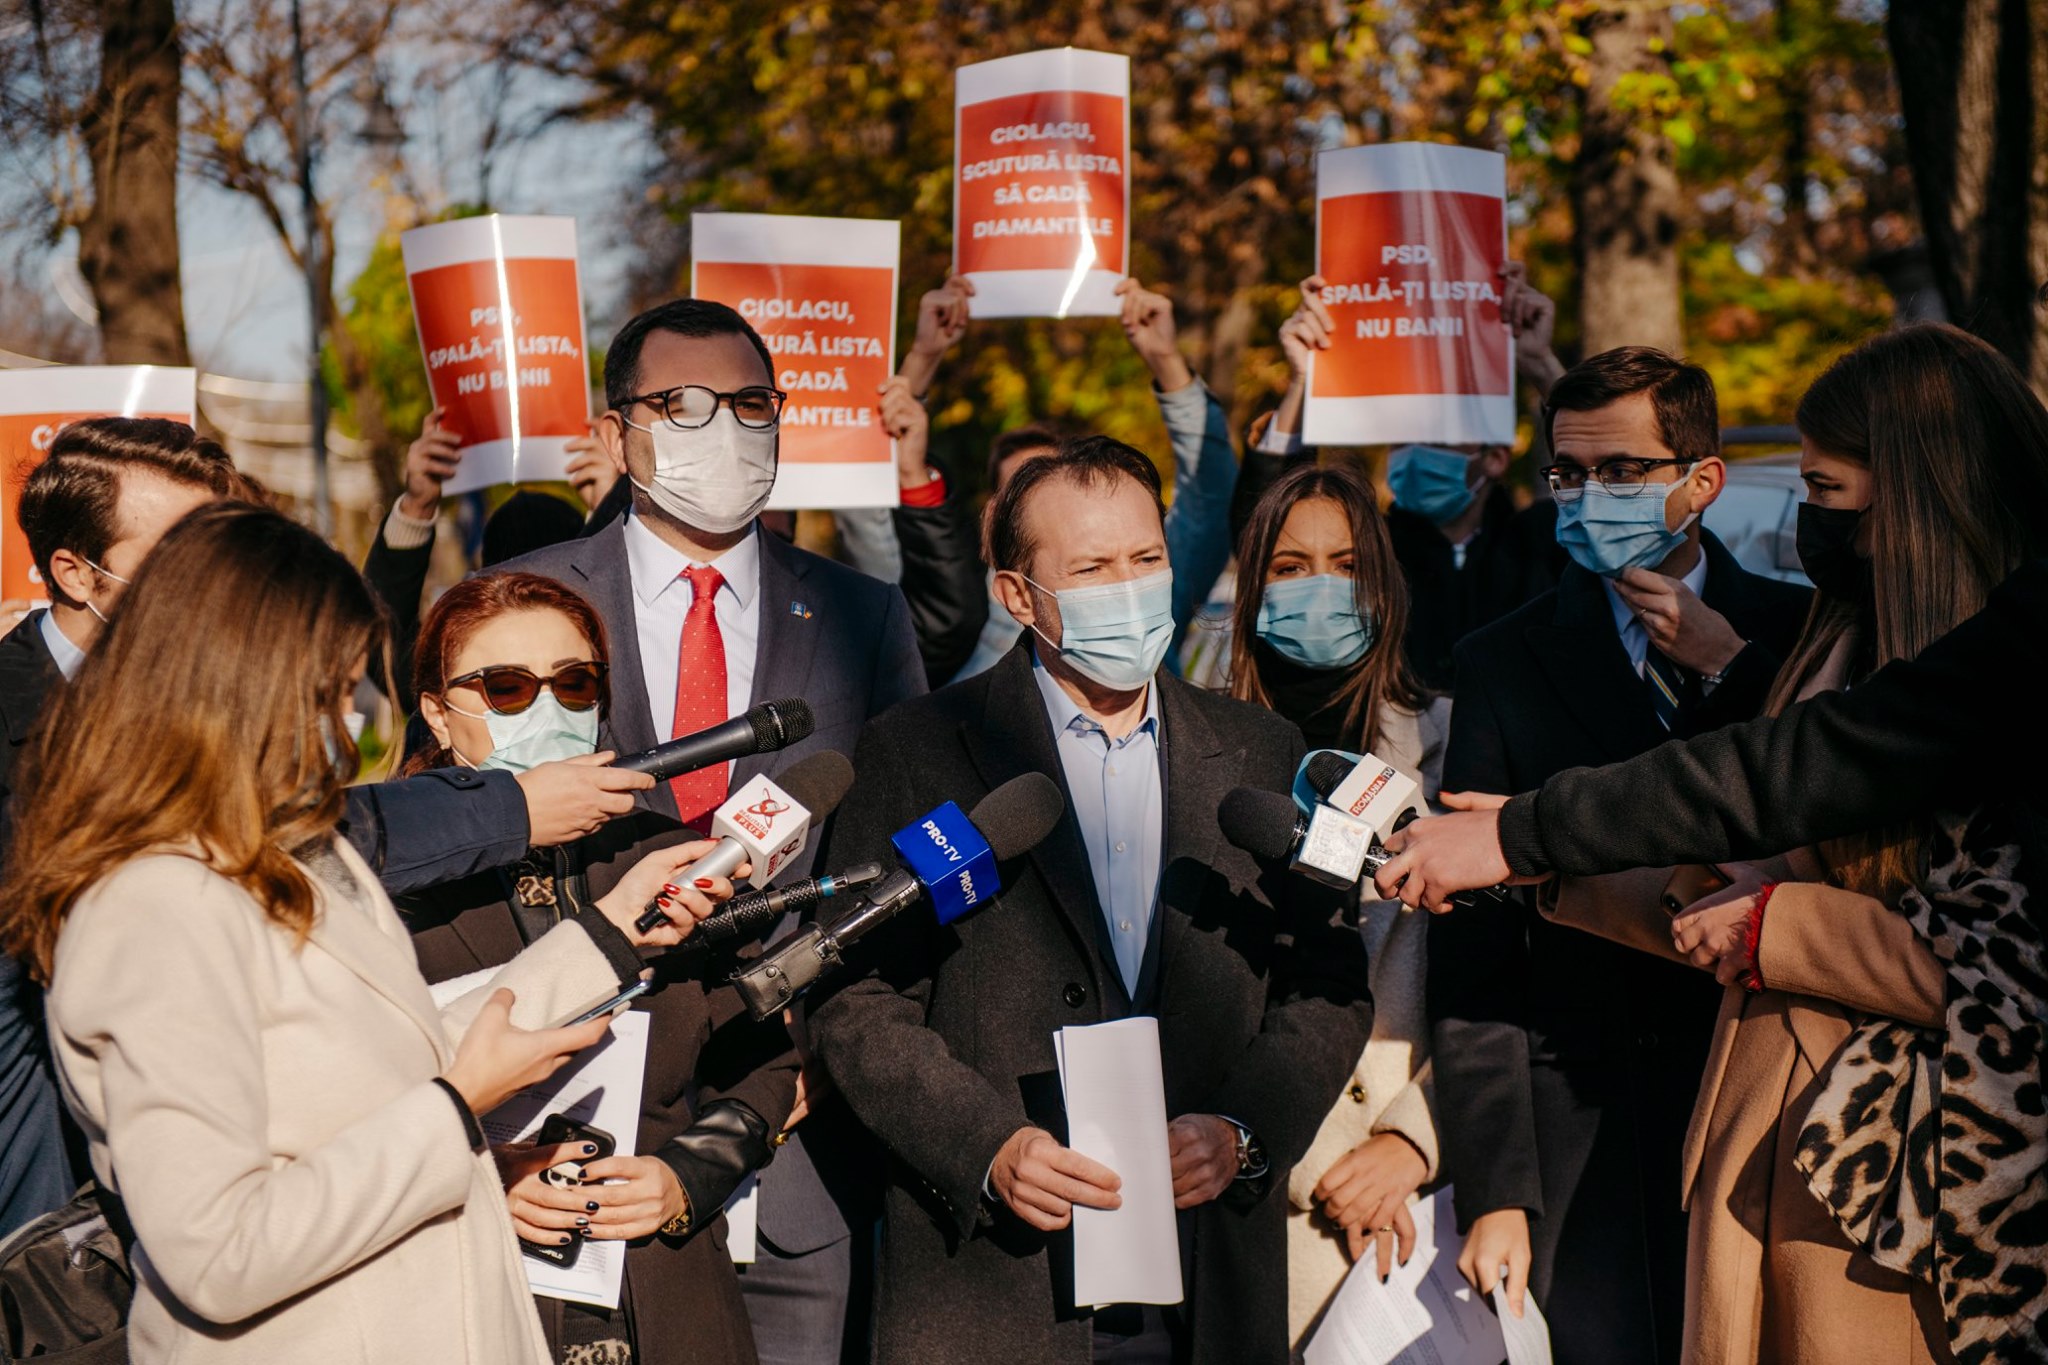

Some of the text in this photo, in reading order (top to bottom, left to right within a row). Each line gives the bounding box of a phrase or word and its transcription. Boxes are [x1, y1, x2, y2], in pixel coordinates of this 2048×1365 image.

[990, 121, 1096, 145] CIOLACU,
[962, 150, 1121, 181] SCUTURĂ LISTA
[993, 181, 1092, 205] SĂ CADĂ
[972, 216, 1114, 239] DIAMANTLE
[1381, 245, 1437, 268] PSD,
[1429, 281, 1503, 304] LISTA,
[738, 298, 855, 325] CIOLACU,
[1356, 317, 1464, 338] NU BANII
[517, 334, 579, 359] LISTA,
[821, 336, 884, 358] LISTA
[457, 366, 551, 395] NU BNII
[779, 366, 849, 392] CADĂ
[738, 816, 761, 837] PLUS
